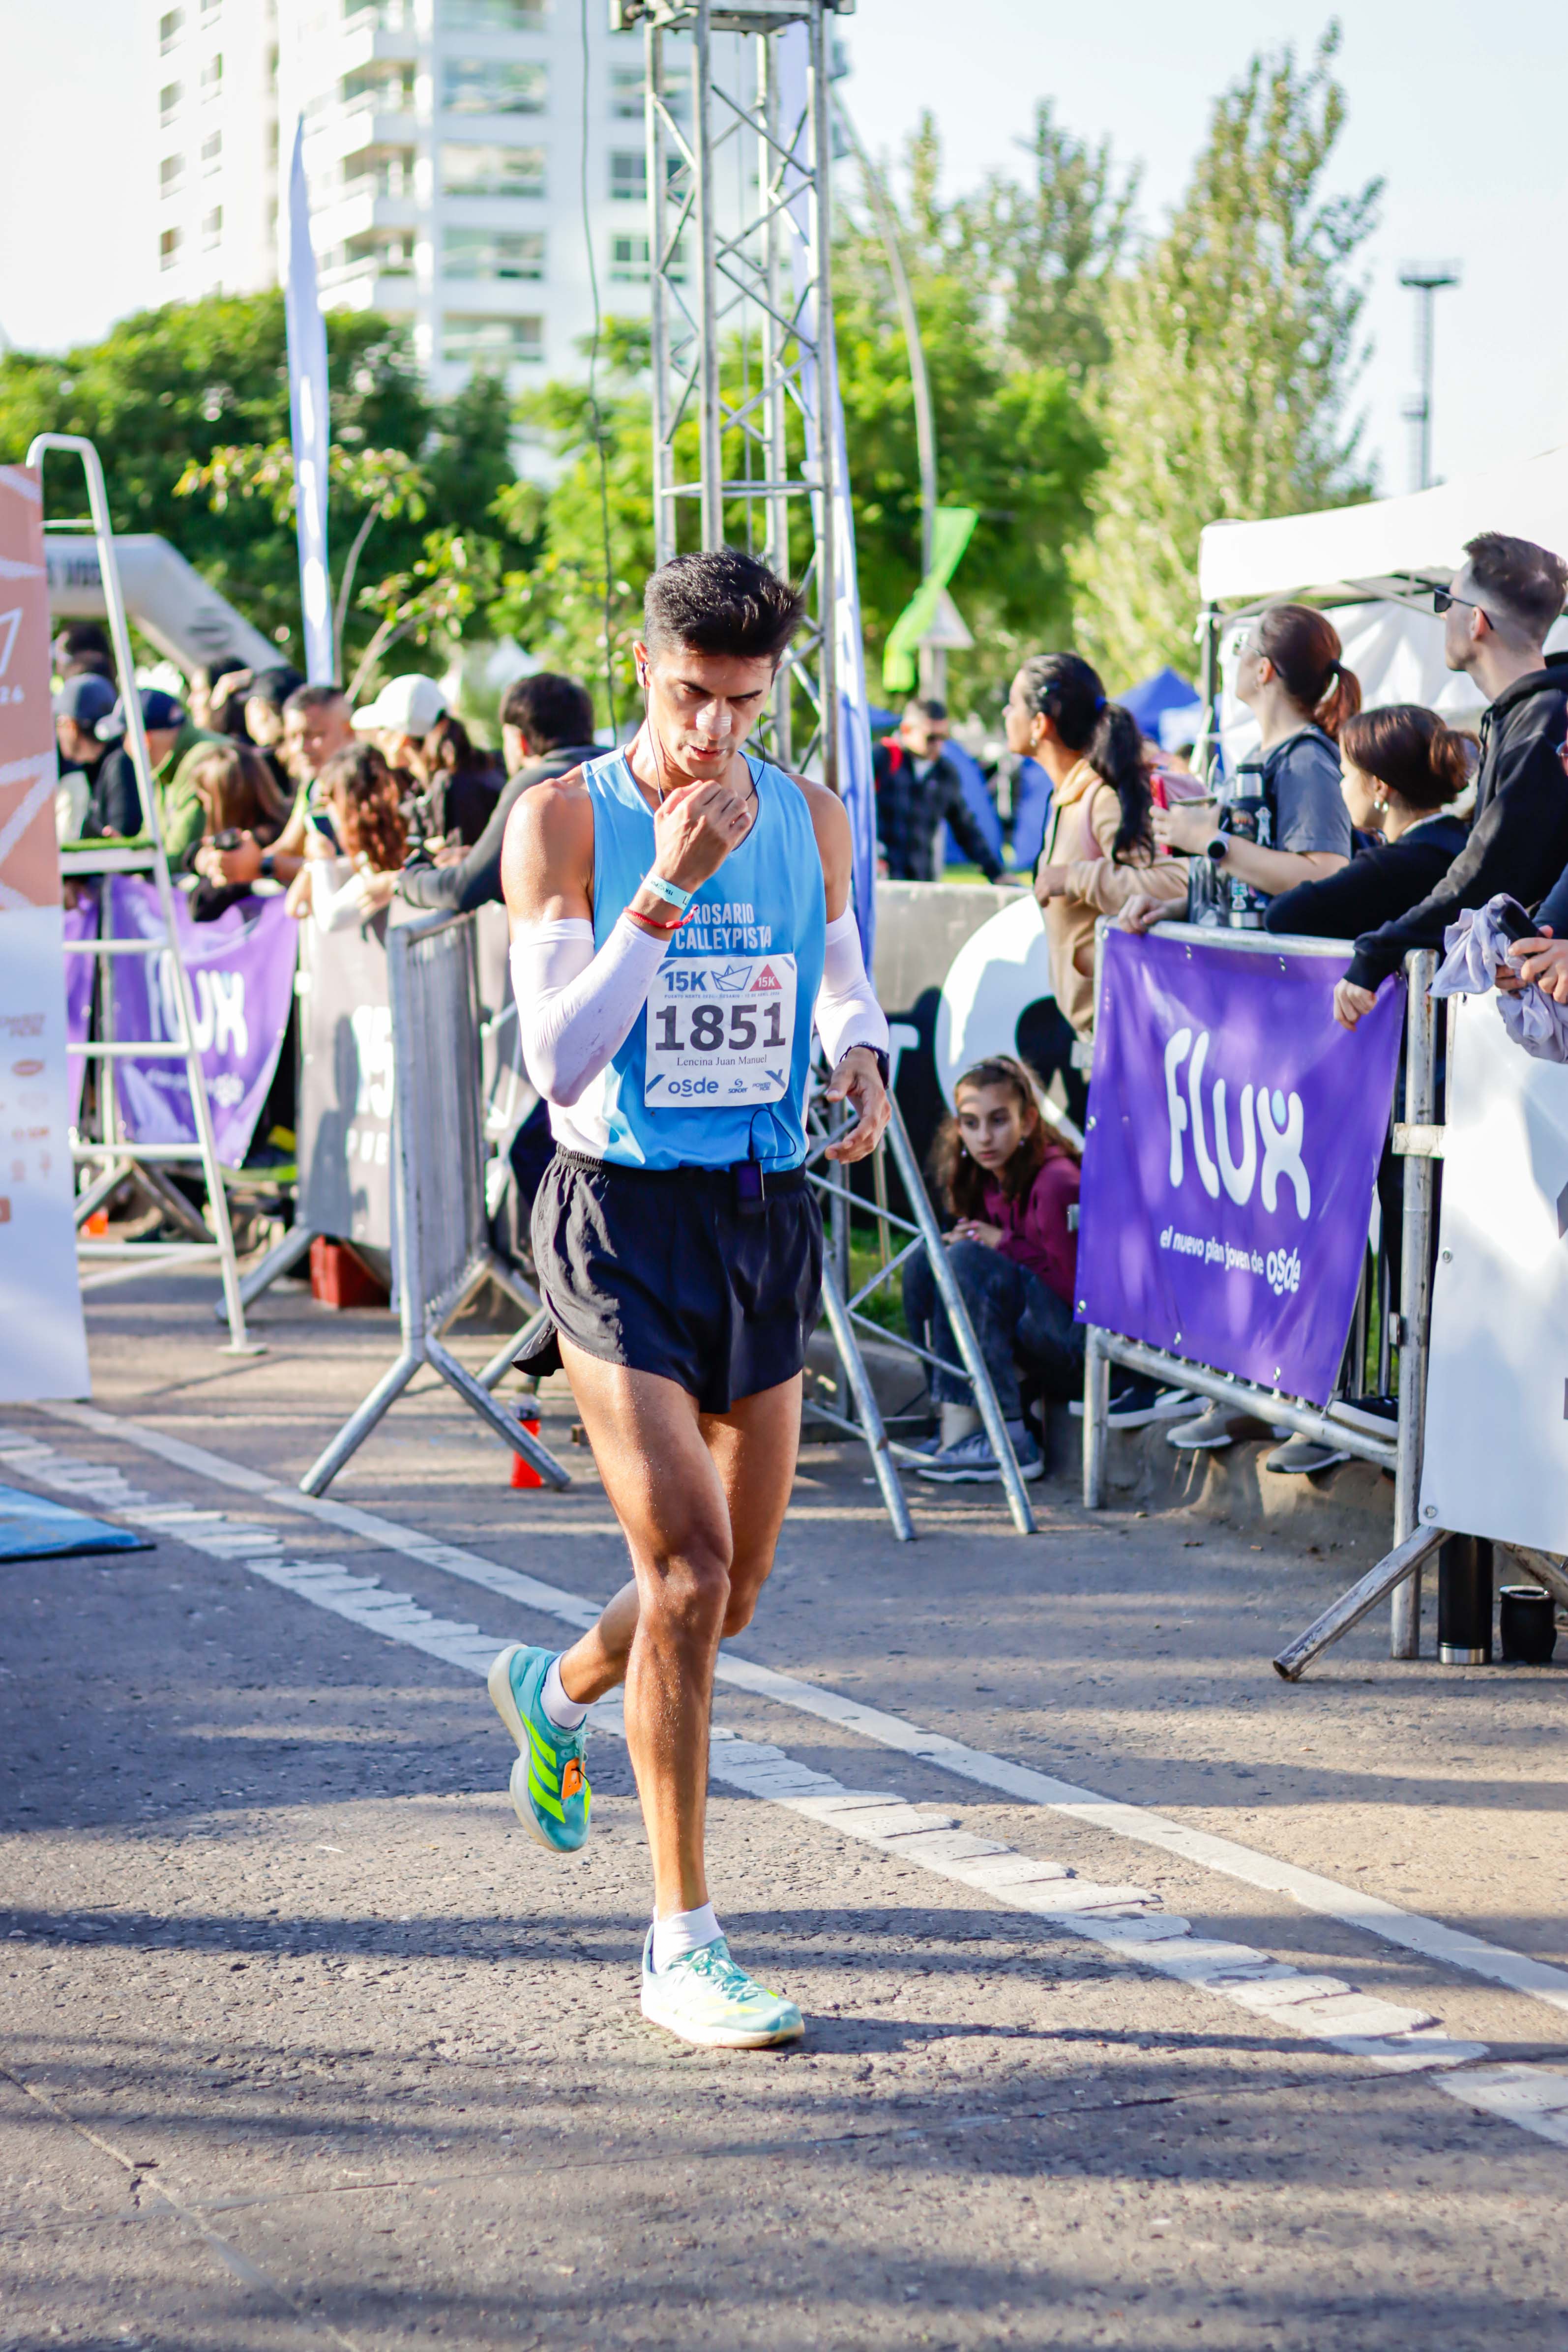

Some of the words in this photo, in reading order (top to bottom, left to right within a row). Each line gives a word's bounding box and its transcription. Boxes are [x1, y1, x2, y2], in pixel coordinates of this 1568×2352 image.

[692, 903, 755, 924] ROSARIO
[675, 926, 771, 950] CALLEYPISTA
[665, 971, 707, 991] 15K
[758, 976, 775, 987] 15K
[655, 1002, 786, 1051] 1851
[677, 1057, 712, 1066] Lencina
[715, 1057, 735, 1065] Juan
[739, 1054, 767, 1064] Manuel
[668, 1077, 719, 1096] osde
[1160, 1225, 1173, 1249] el
[1172, 1232, 1204, 1257] nuevo
[1205, 1236, 1225, 1265] plan
[1225, 1241, 1250, 1271] joven
[1251, 1249, 1264, 1275] de
[1266, 1247, 1301, 1295] osde
